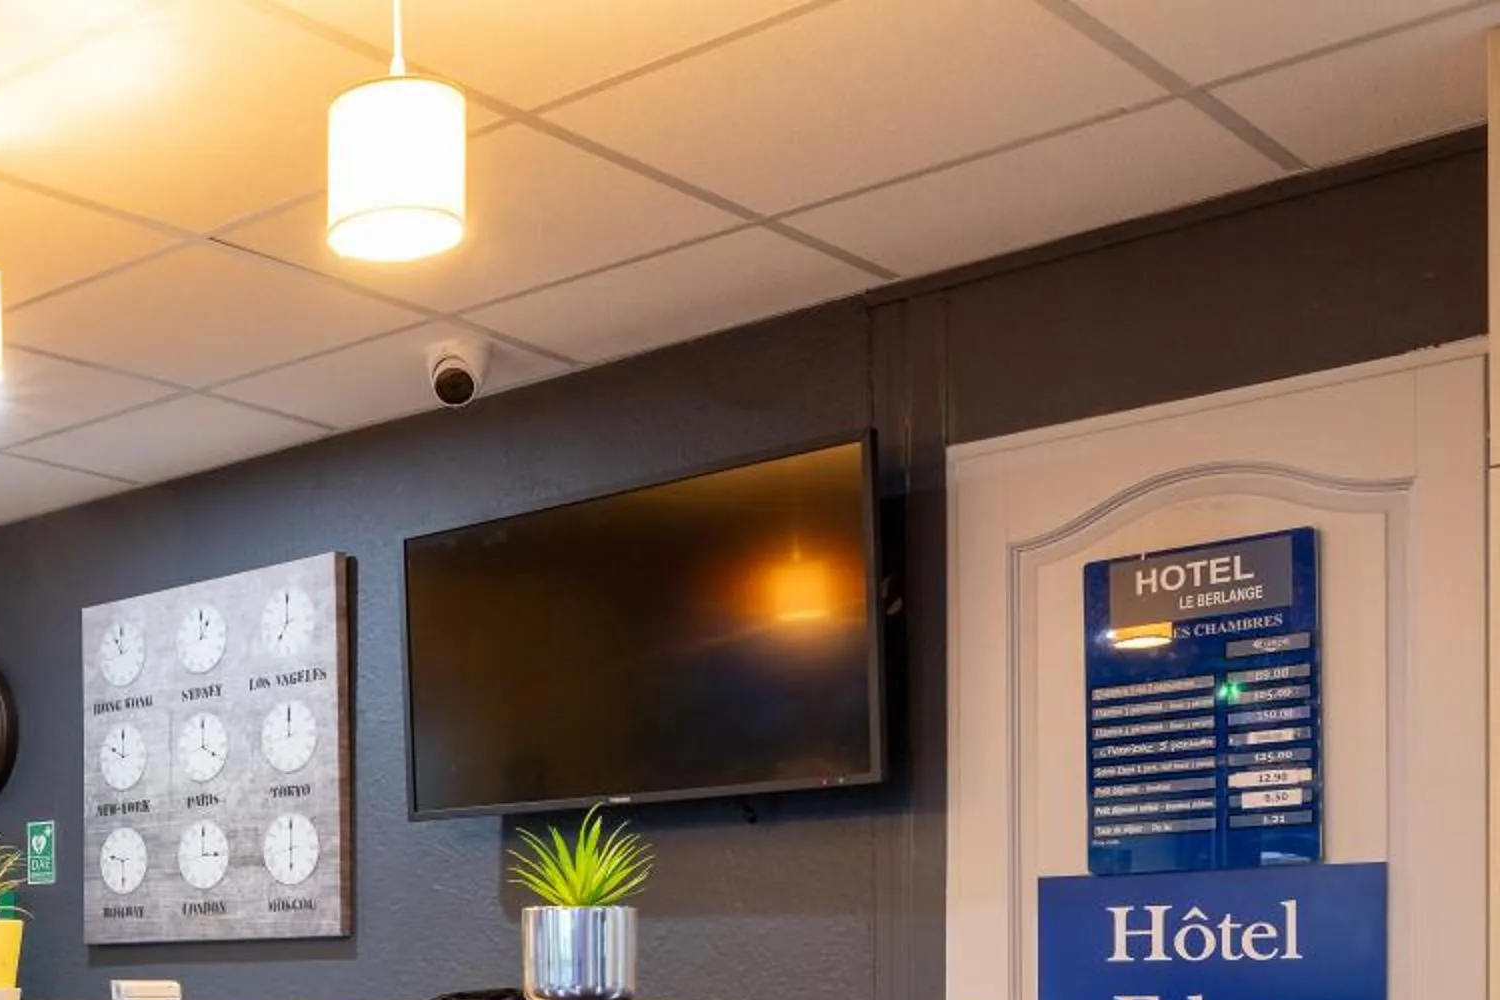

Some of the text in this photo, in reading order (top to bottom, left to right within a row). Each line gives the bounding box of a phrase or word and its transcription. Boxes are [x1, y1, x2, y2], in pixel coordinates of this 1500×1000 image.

[1135, 555, 1255, 596] HOTEL
[1179, 585, 1264, 610] LE BERLANGE
[1173, 613, 1284, 639] ES CHAMBRES
[249, 667, 328, 691] LOS ANGELES
[181, 684, 223, 702] SYDNEY
[186, 792, 220, 809] PARIS
[269, 783, 312, 799] TOKYO
[1105, 899, 1304, 962] Hôtel
